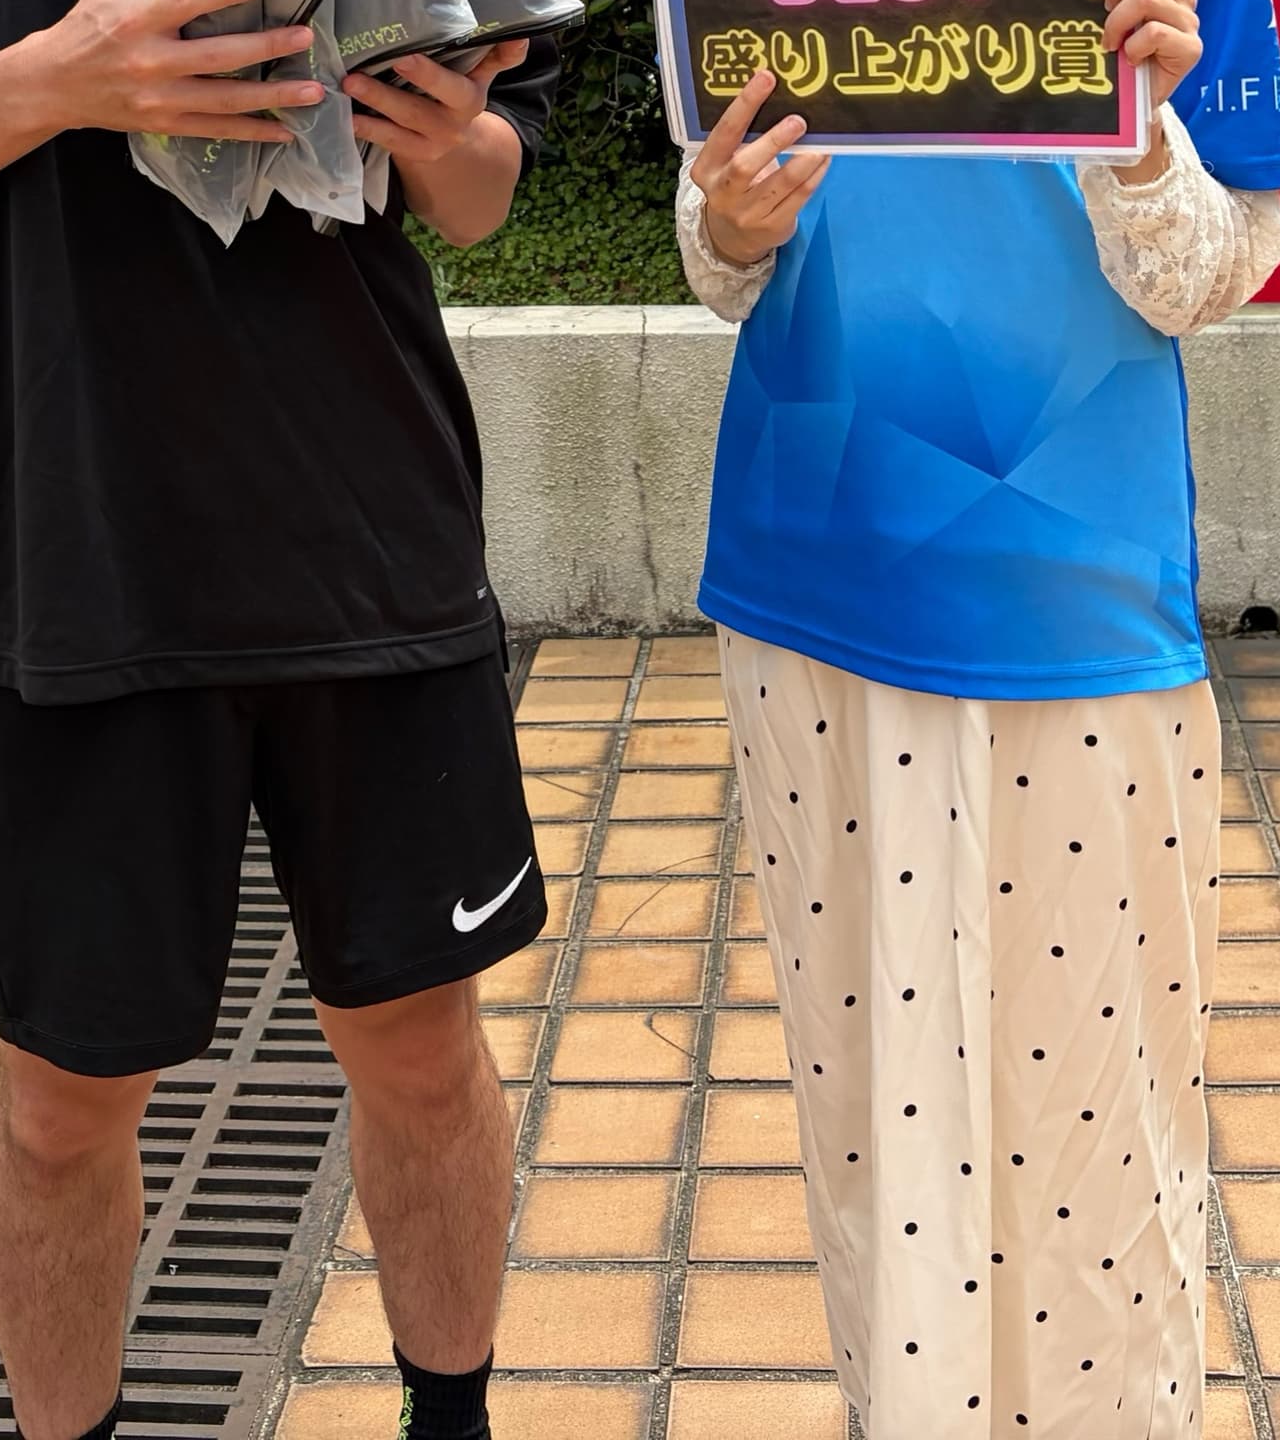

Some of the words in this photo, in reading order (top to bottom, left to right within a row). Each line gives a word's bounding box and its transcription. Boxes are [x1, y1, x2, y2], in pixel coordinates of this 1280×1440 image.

[701, 20, 1115, 98] 盛り上がり賞
